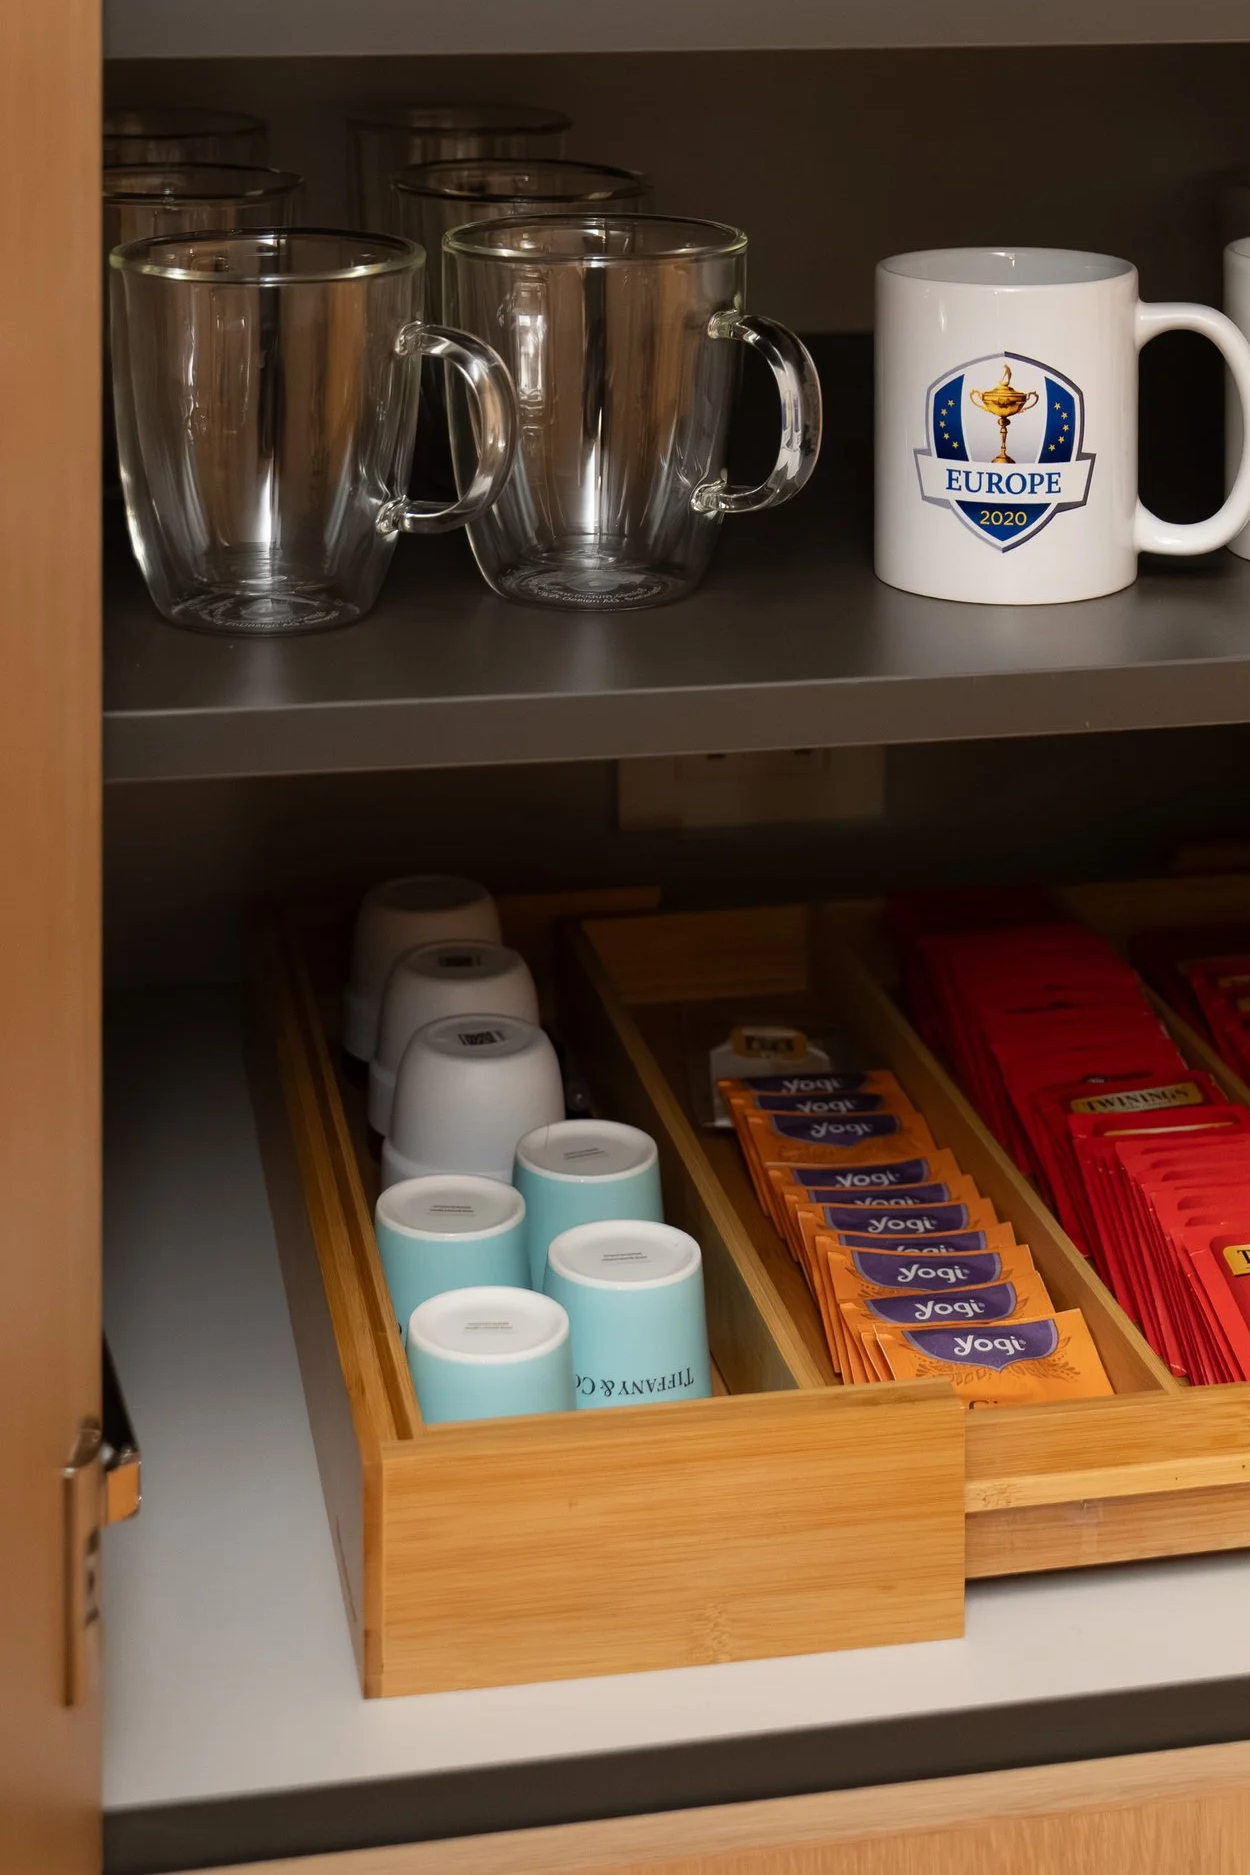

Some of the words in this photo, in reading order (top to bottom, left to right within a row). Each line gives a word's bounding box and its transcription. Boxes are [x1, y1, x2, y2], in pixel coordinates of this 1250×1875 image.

[945, 468, 1062, 495] EUROPE
[979, 510, 1028, 526] 2020
[1086, 1089, 1190, 1112] TWININGS
[810, 1121, 872, 1138] yogi
[835, 1169, 898, 1188] yogi
[867, 1216, 936, 1233] yogi
[897, 1264, 968, 1283] yogi
[914, 1299, 985, 1320] yogi
[953, 1334, 1026, 1356] yogi
[600, 1379, 616, 1397] &
[618, 1367, 695, 1397] TIFFANY
